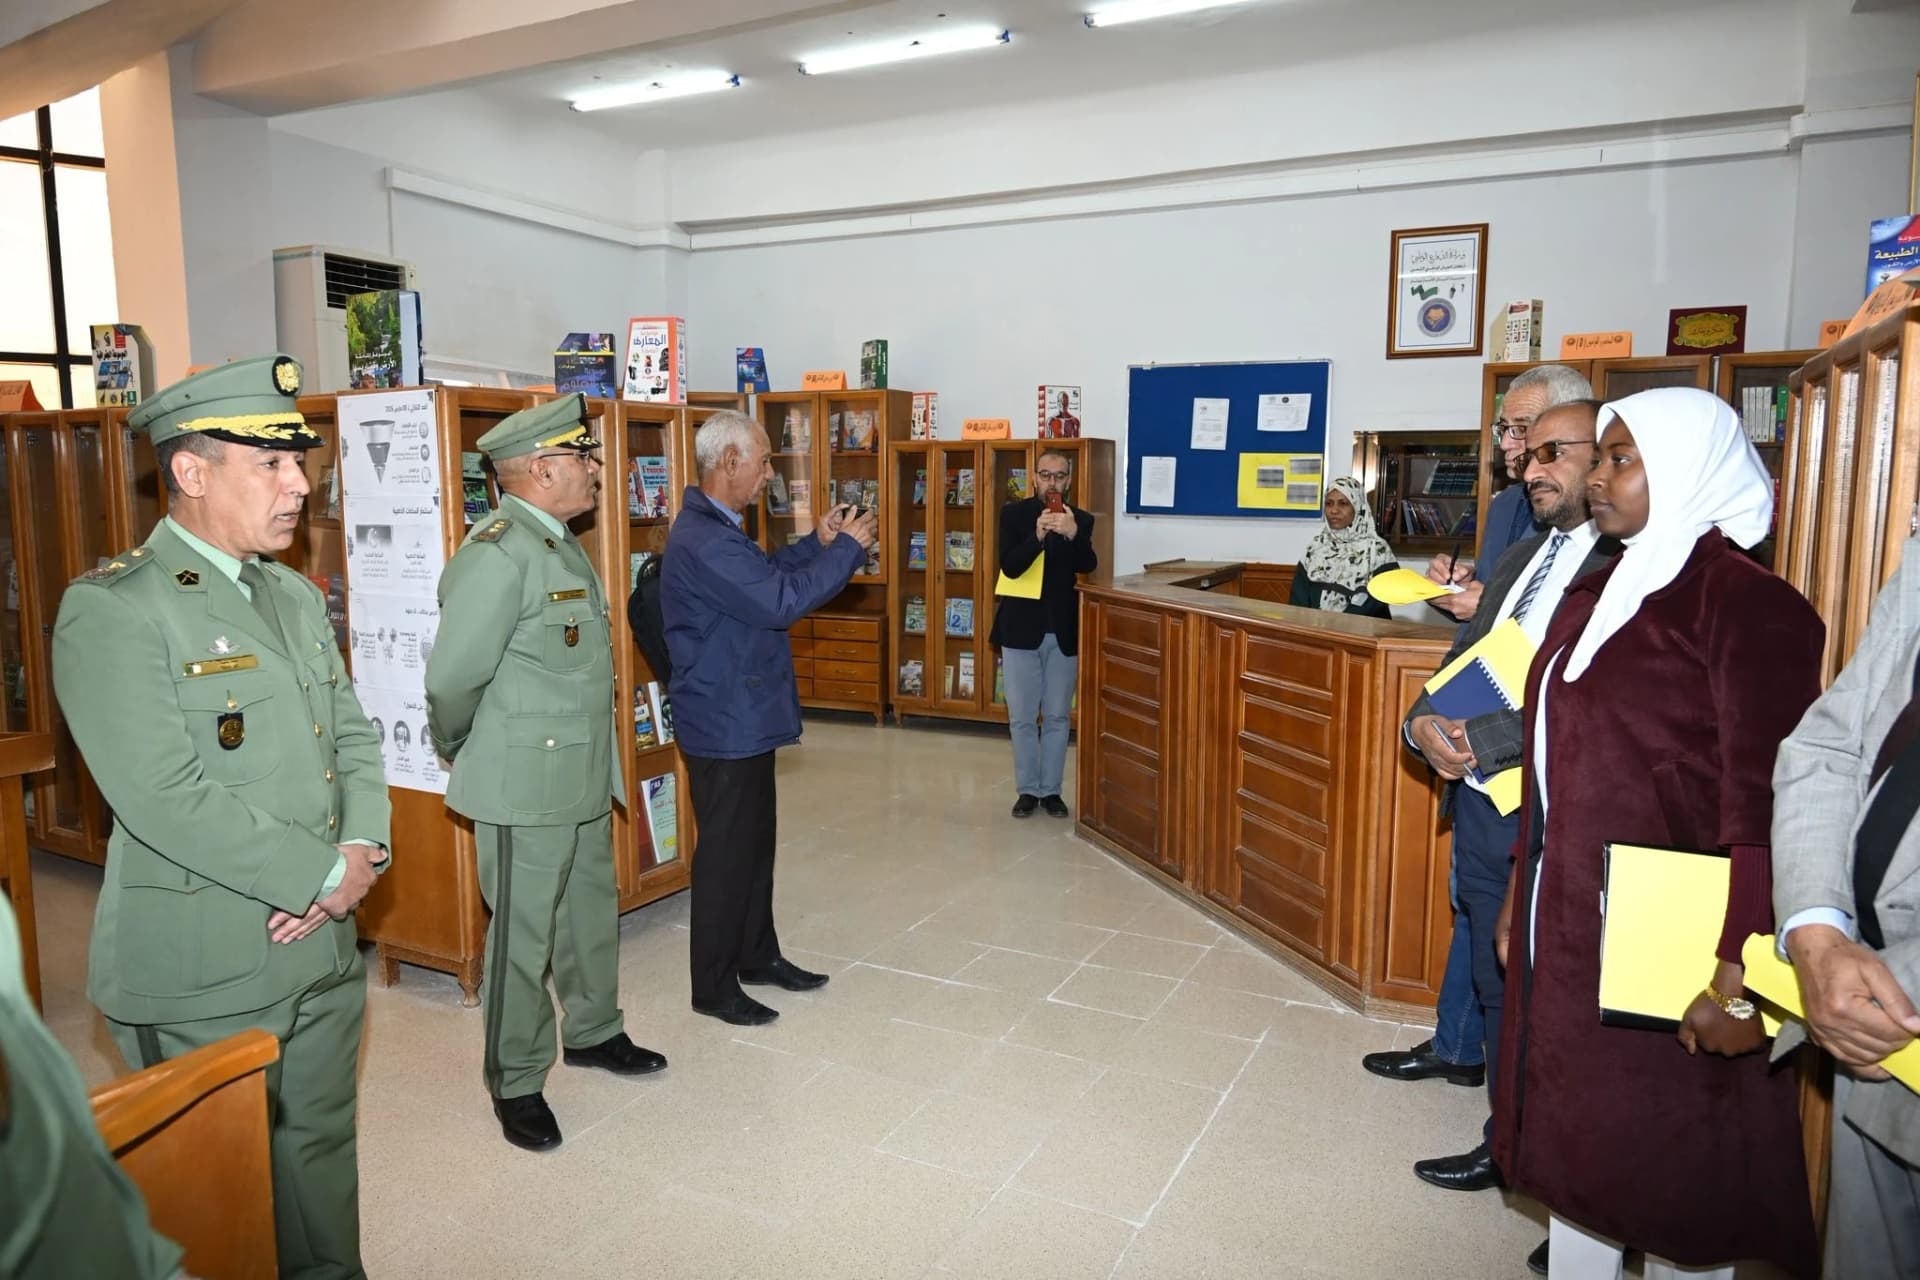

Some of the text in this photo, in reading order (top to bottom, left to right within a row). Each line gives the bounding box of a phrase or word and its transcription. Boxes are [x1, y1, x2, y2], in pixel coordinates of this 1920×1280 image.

[1874, 246, 1919, 261] الطبيعة
[633, 334, 667, 348] المعارف
[951, 614, 961, 628] 2
